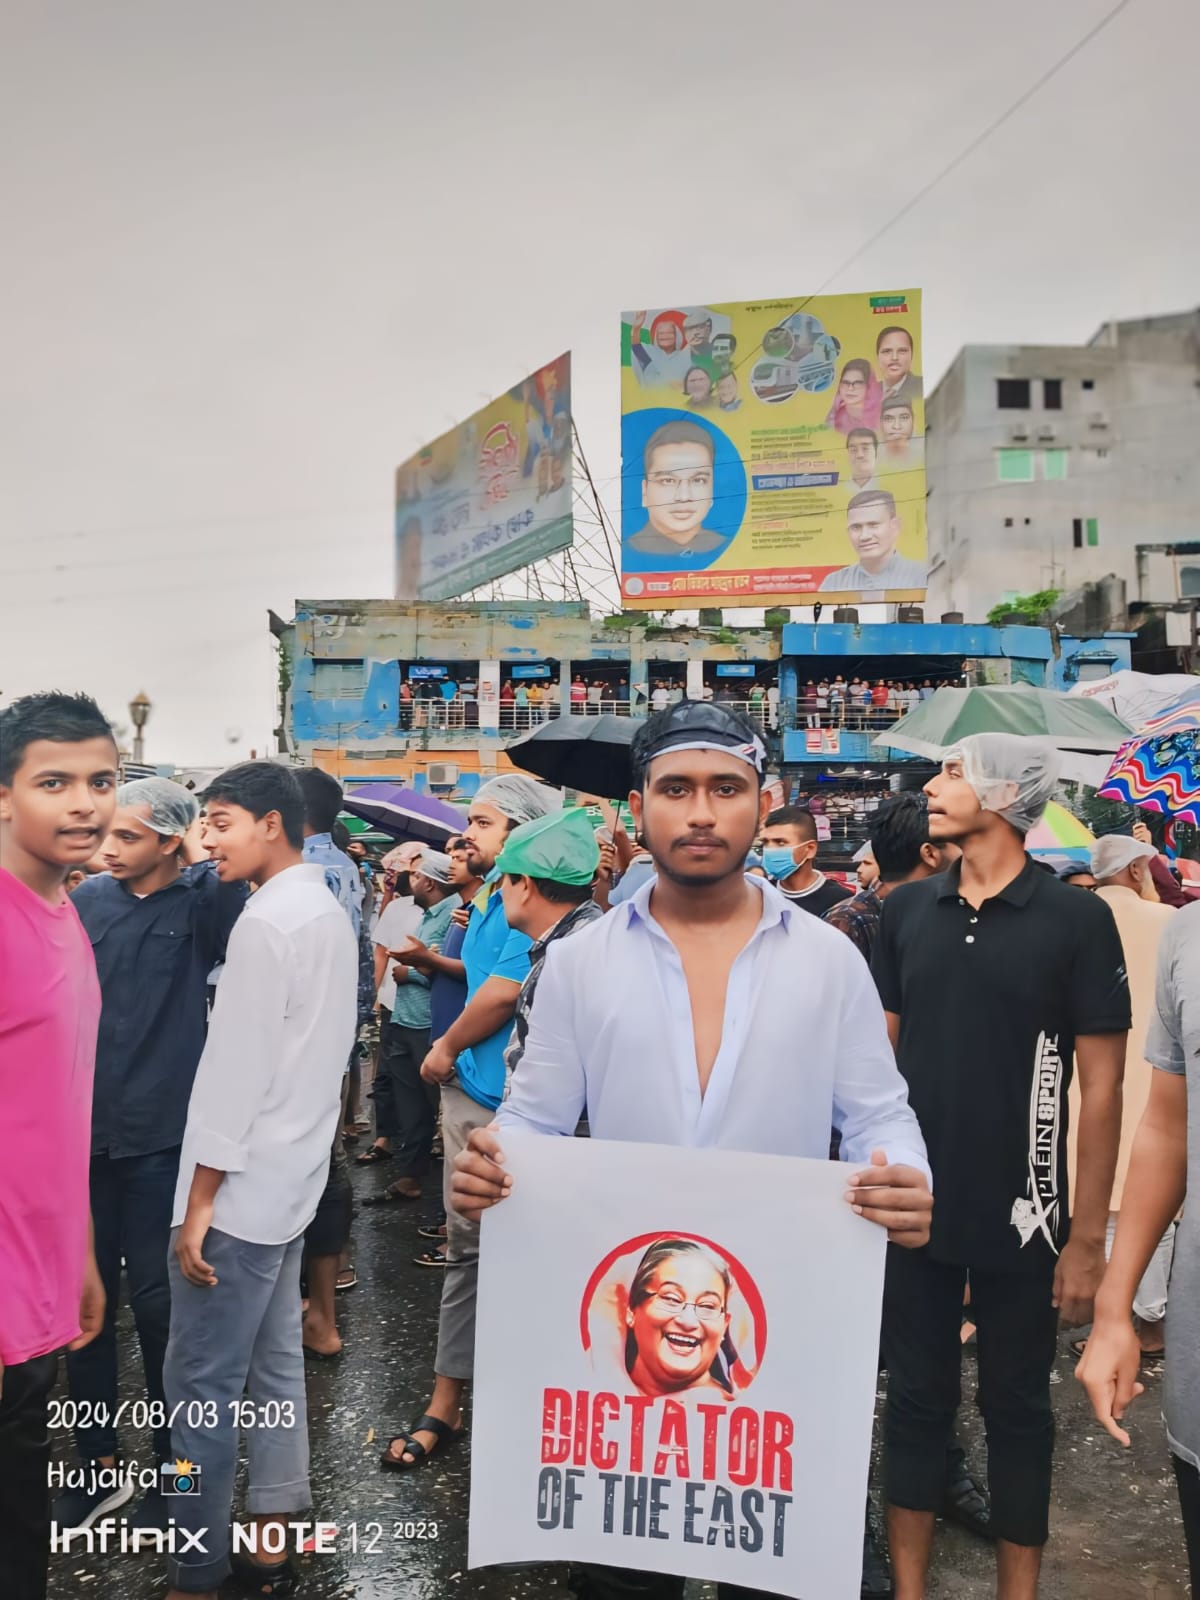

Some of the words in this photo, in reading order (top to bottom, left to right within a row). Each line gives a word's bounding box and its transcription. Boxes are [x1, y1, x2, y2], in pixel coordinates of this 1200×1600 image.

[541, 1387, 795, 1491] DICTATOR
[536, 1466, 585, 1530] OF
[599, 1471, 671, 1539] THE
[683, 1481, 793, 1557] EAST
